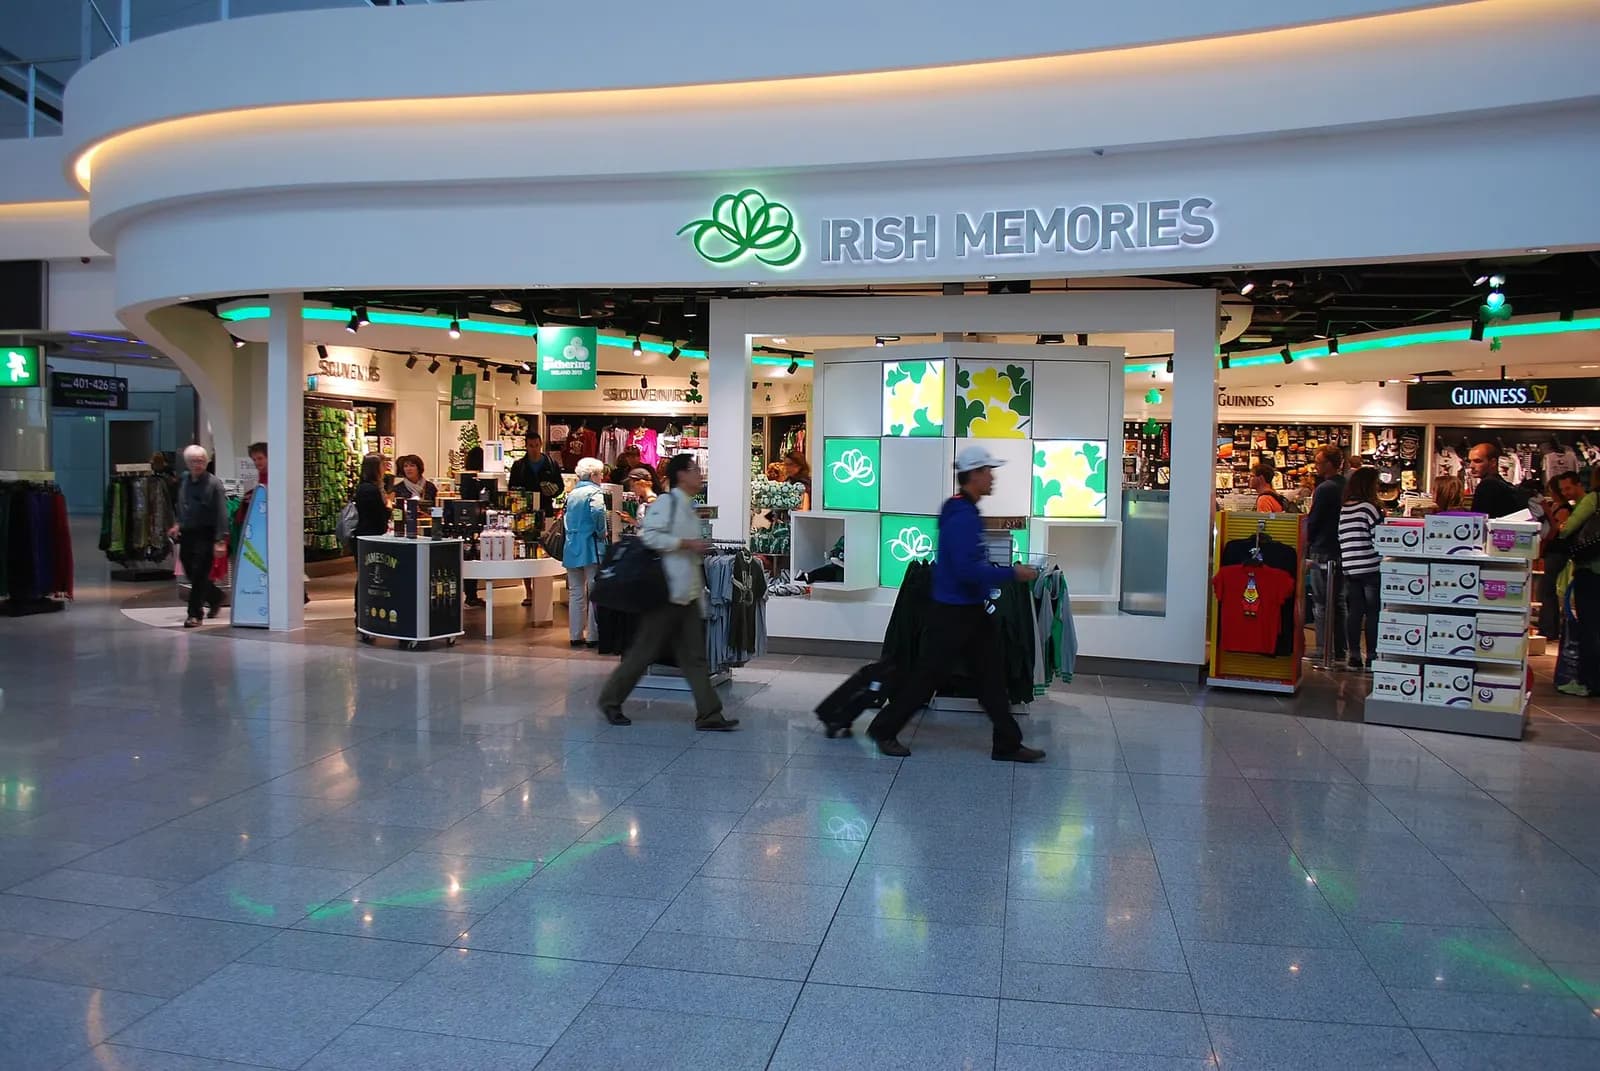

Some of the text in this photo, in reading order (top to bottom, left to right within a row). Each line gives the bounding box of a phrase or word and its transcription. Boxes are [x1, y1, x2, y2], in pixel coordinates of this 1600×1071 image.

[821, 198, 1214, 261] IRISH MEMORIES
[73, 377, 109, 391] 401-426
[1218, 393, 1275, 407] GUINNESS
[1451, 386, 1527, 405] GUINNESS
